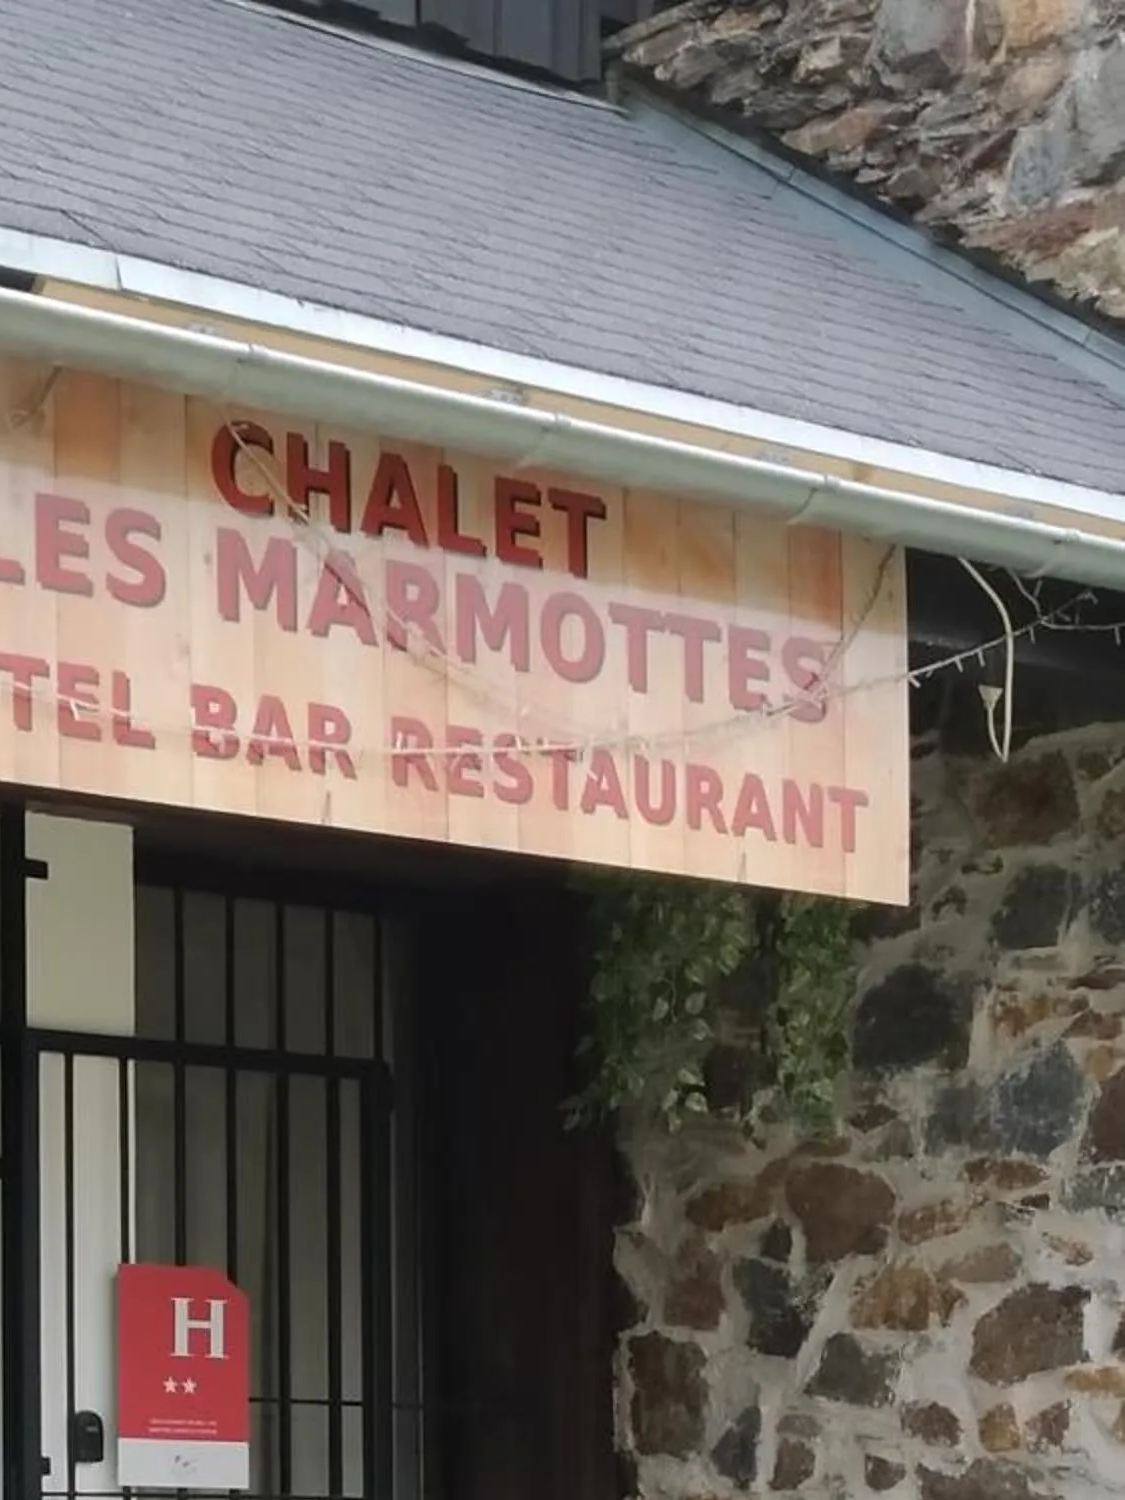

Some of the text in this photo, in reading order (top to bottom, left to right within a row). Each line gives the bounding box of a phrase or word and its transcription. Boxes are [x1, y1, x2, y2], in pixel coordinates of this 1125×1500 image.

[210, 420, 607, 580] CHALET
[215, 527, 829, 724] MARMOTTES
[190, 682, 357, 779] BAR
[390, 715, 869, 854] RESTAURANT
[170, 1297, 230, 1360] H
